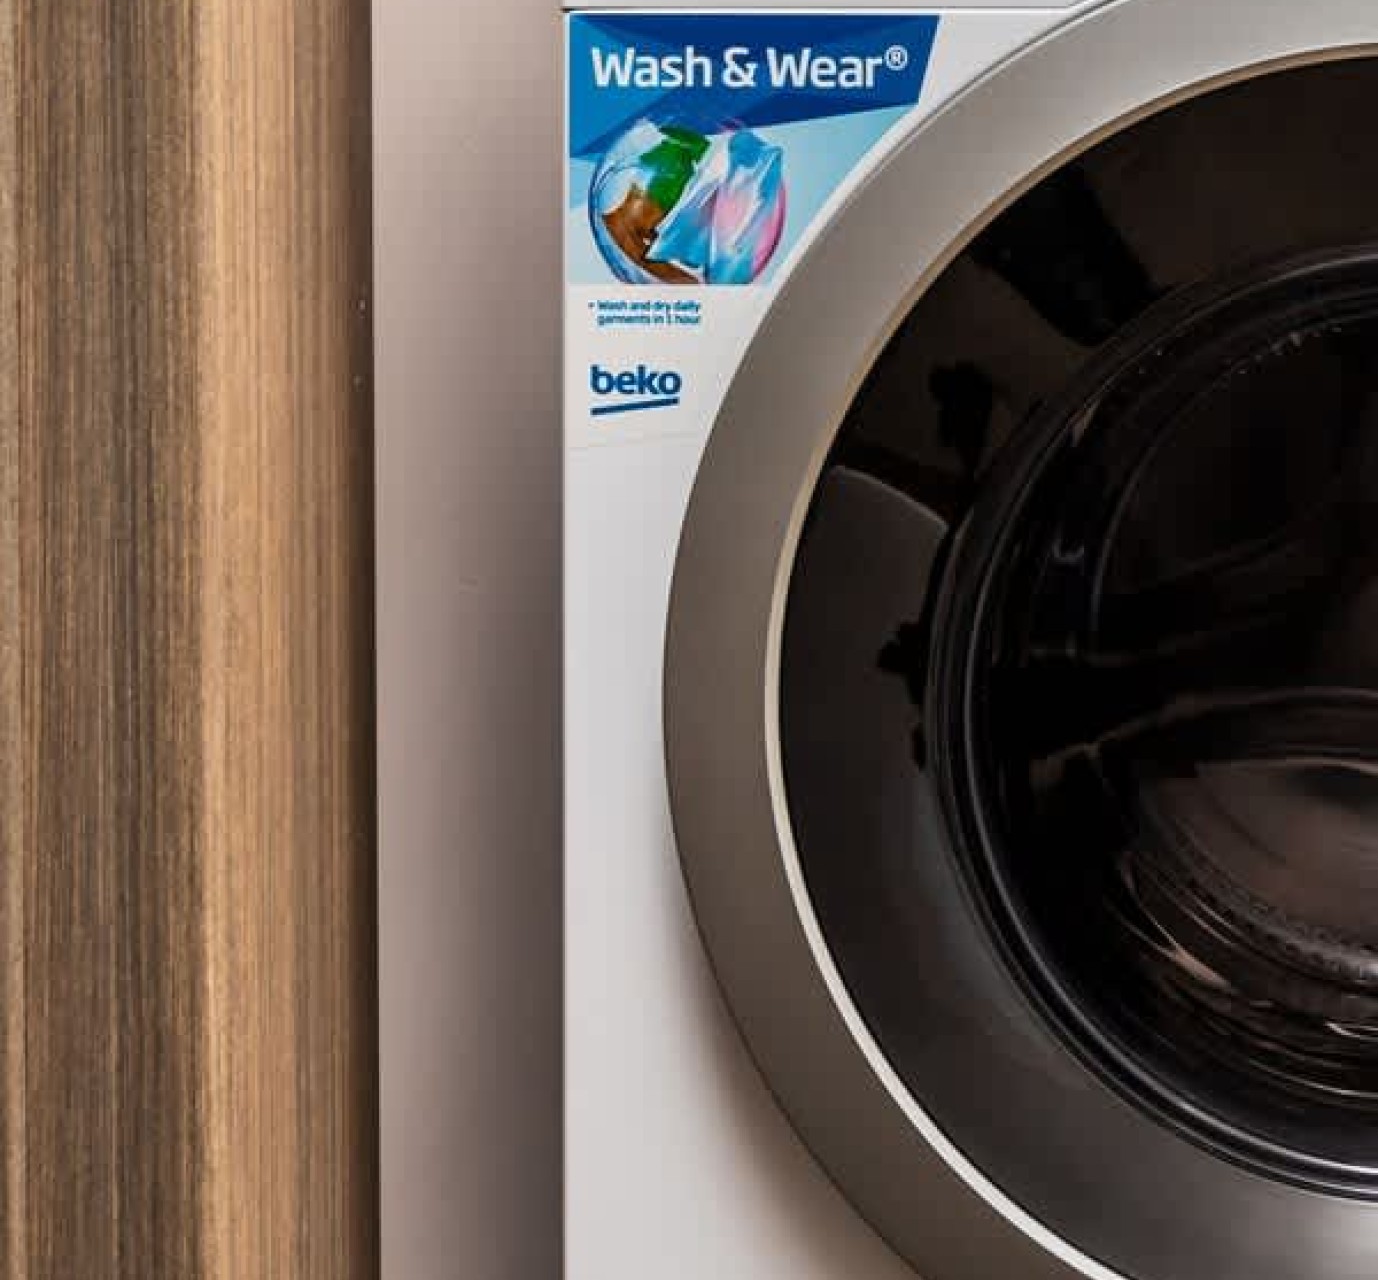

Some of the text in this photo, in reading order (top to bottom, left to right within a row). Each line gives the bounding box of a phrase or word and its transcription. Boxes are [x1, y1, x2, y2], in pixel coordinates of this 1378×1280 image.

[591, 45, 712, 89] Wash
[722, 47, 756, 88] &
[590, 364, 682, 395] beko
